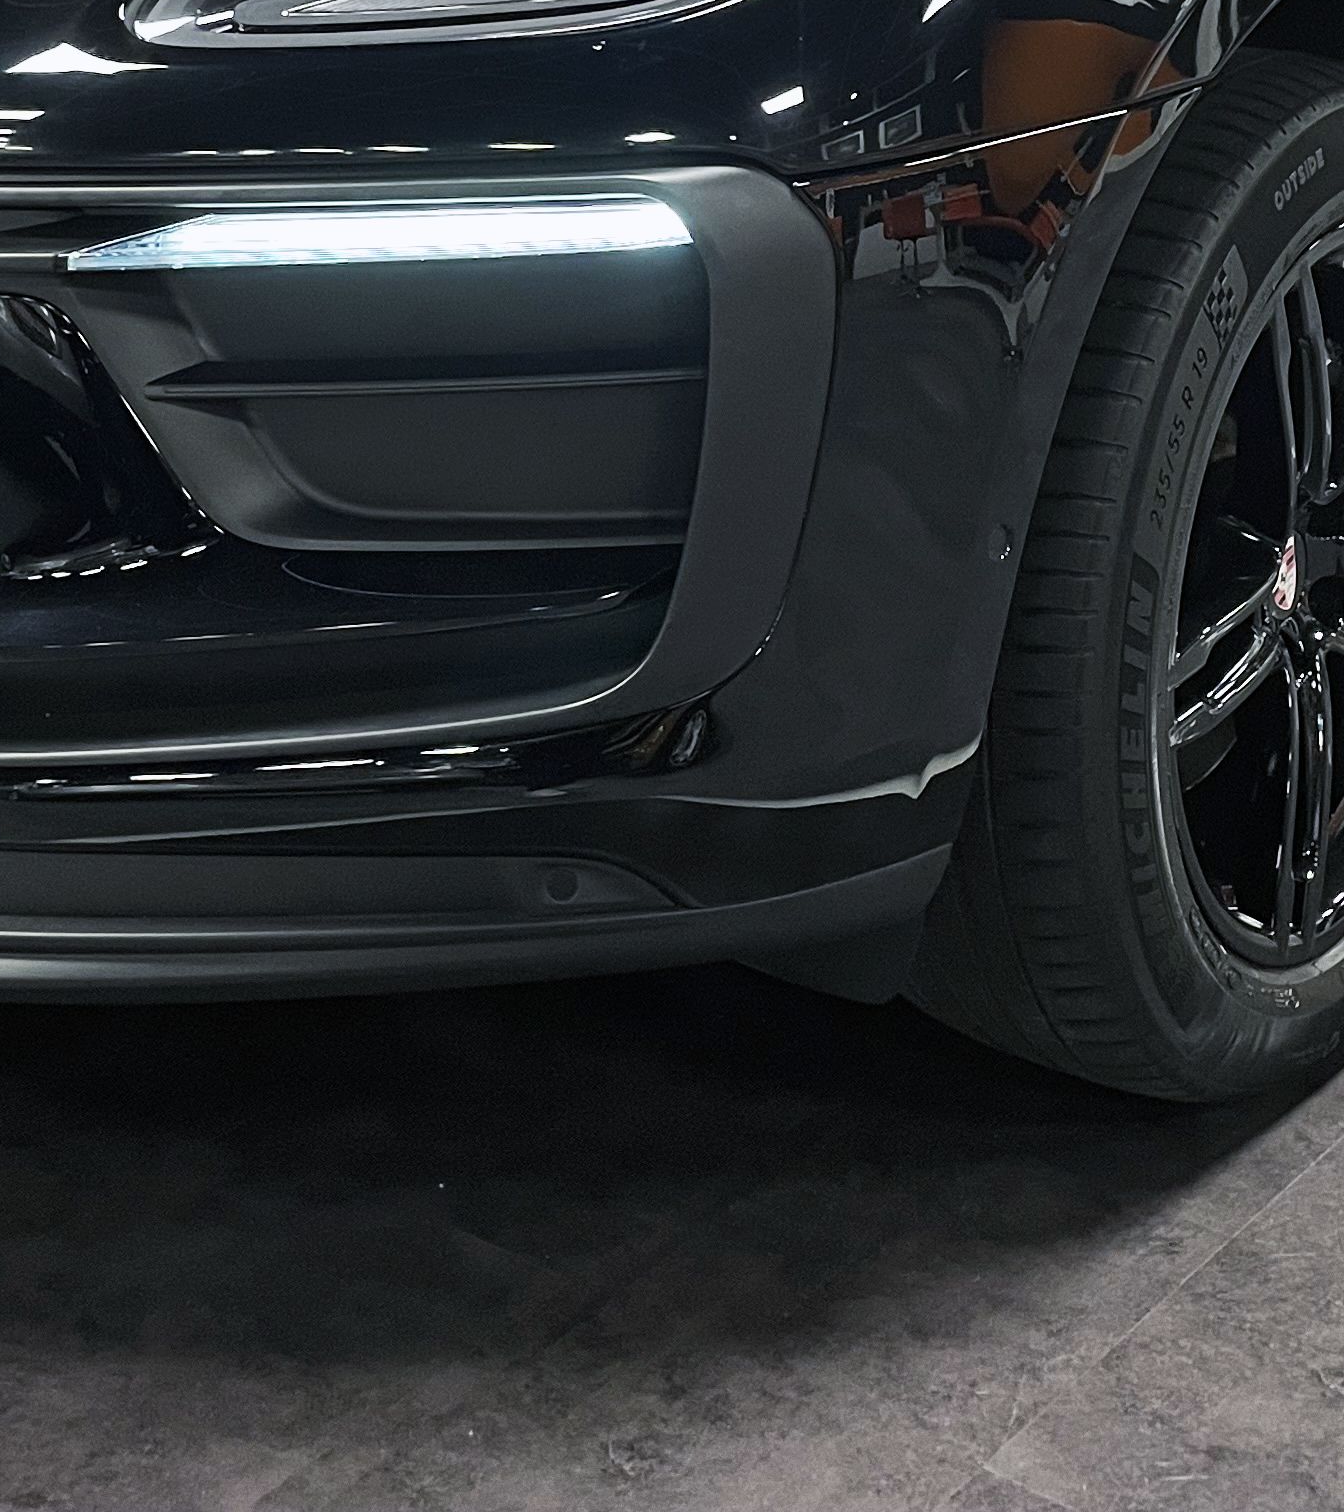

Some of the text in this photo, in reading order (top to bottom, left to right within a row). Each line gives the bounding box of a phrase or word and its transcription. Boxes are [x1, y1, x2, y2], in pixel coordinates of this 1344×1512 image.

[1273, 147, 1326, 211] OUTSIDE
[1182, 386, 1195, 408] R
[1191, 347, 1209, 379] 19
[1119, 579, 1171, 938] MICHELIN
